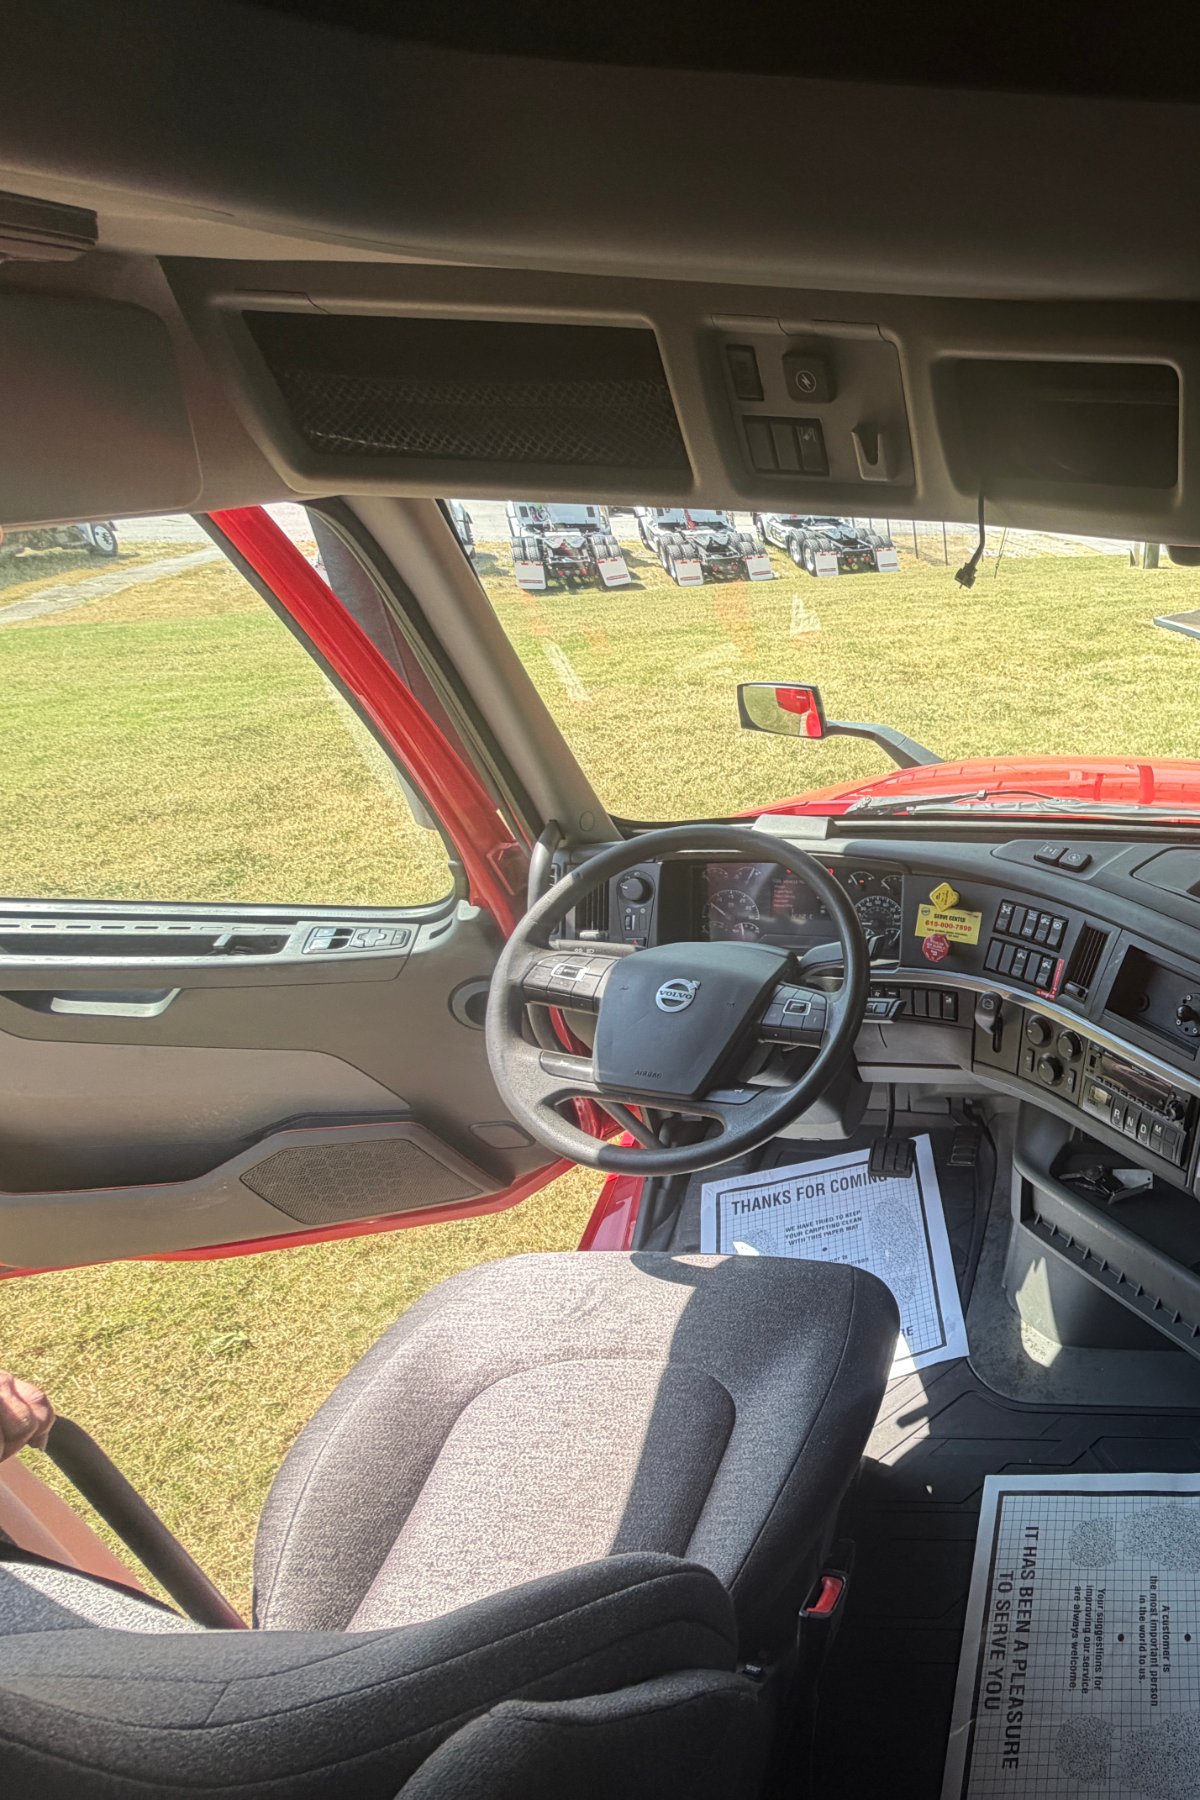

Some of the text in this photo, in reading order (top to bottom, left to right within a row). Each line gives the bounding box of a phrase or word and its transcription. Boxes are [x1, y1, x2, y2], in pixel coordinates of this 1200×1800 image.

[660, 990, 692, 999] VOLVO
[1114, 1108, 1120, 1119] R
[1127, 1116, 1134, 1127] N
[1140, 1124, 1147, 1133] D
[1154, 1125, 1162, 1133] M
[732, 1190, 791, 1215] THANKS
[796, 1183, 825, 1201] FOR
[1150, 1576, 1158, 1589] the
[1083, 1585, 1094, 1633] improving
[1139, 1595, 1147, 1603] in
[1070, 1604, 1081, 1638] always
[984, 1571, 1014, 1710] TO SERVE YOU
[1002, 1526, 1039, 1769] IT HAS BEEN A PLEASURE
[1094, 1588, 1106, 1690] Your suggestions for
[1139, 1625, 1147, 1651] world
[1149, 1619, 1158, 1667] important
[1069, 1642, 1080, 1692] welcome.
[1139, 1655, 1146, 1664] to
[1163, 1664, 1171, 1672] is
[1081, 1656, 1091, 1694] service
[1149, 1671, 1158, 1706] person
